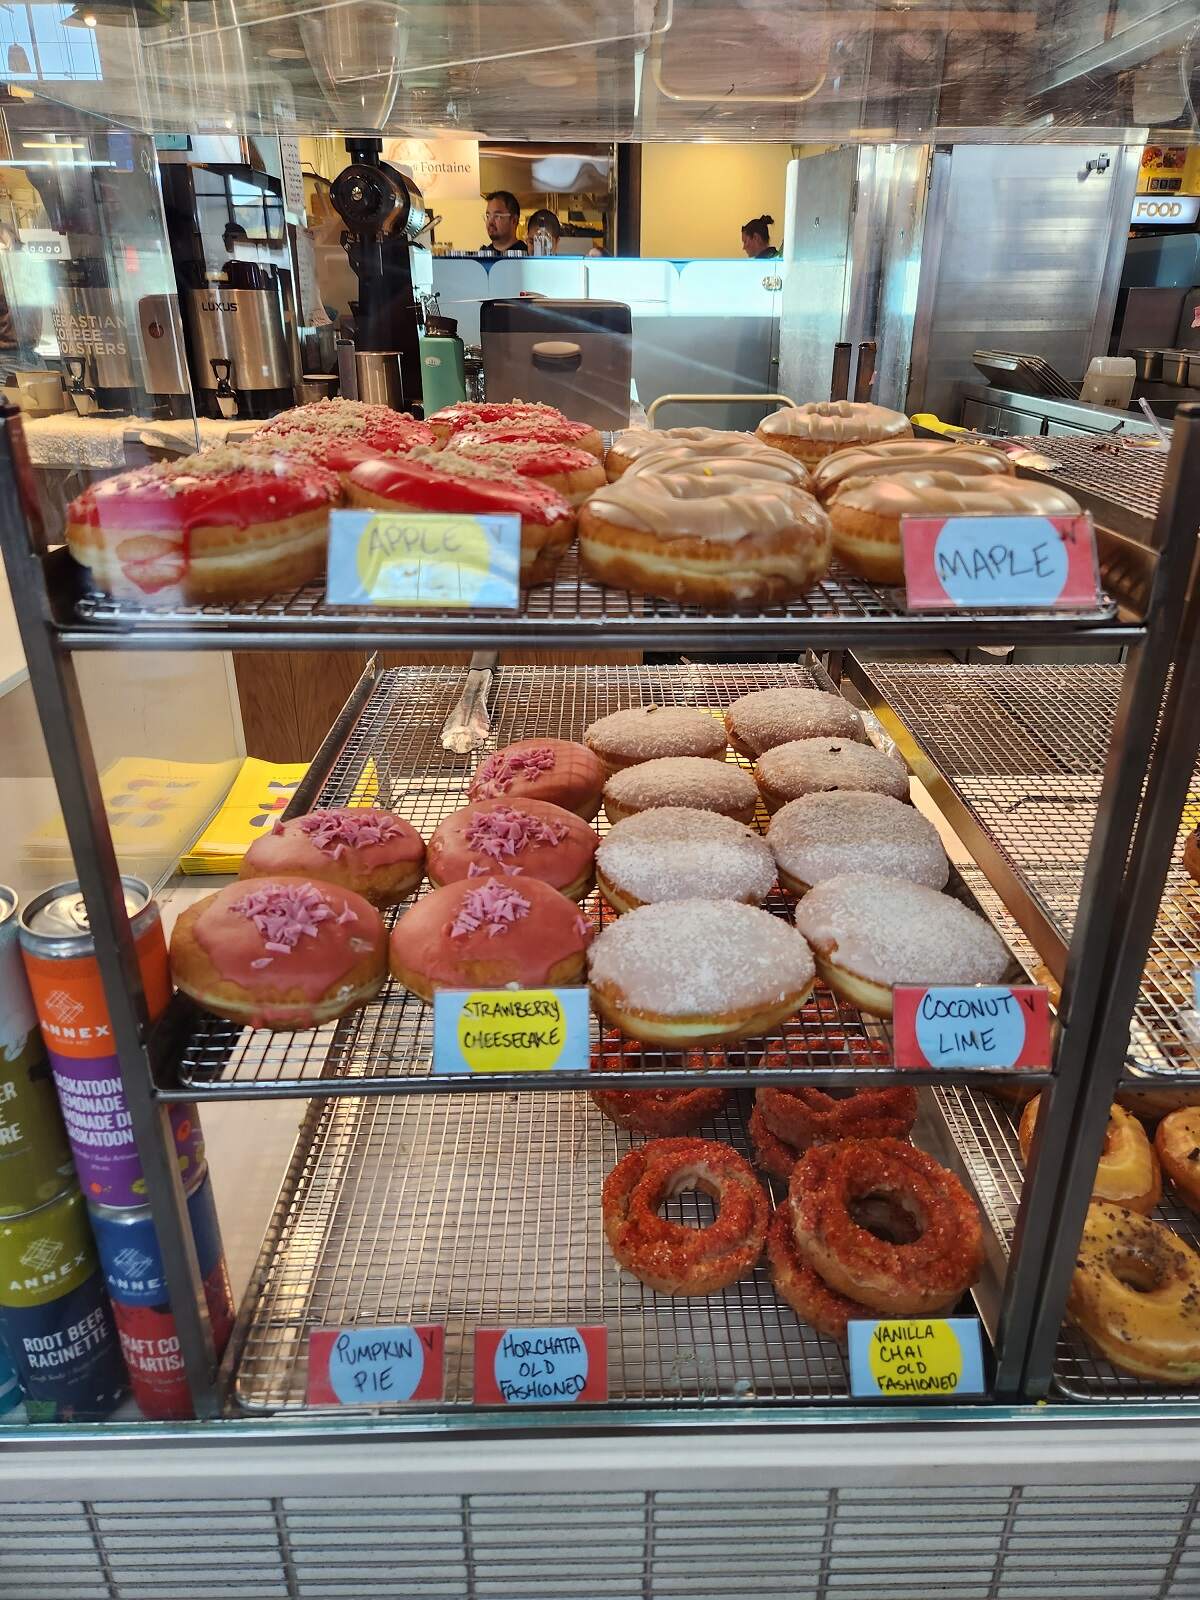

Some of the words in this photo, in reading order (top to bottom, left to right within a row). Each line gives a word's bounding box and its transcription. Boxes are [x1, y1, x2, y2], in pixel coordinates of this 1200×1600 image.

[420, 161, 471, 173] Fontaine
[1136, 202, 1182, 217] FOOD
[202, 302, 238, 312] LUXUS
[367, 525, 463, 558] APPLE
[937, 542, 1055, 582] MAPLE
[463, 1000, 561, 1022] STRAWBERRY
[922, 994, 1013, 1020] COCONUT
[41, 1019, 111, 1039] ANNEX
[463, 1027, 561, 1049] CHEESECAKE
[939, 1028, 997, 1053] LIME
[9, 1251, 87, 1292] ANNEX
[108, 1274, 168, 1291] ANNE
[23, 1331, 63, 1353] ROOT
[67, 1306, 105, 1342] BEER
[873, 1325, 935, 1343] VANILLA
[27, 1321, 109, 1369] RACINETTE
[336, 1334, 413, 1365] PUMPKIN
[503, 1333, 581, 1358] HORCHATA
[880, 1345, 923, 1362] CHAI
[519, 1359, 555, 1378] OLD
[896, 1361, 927, 1375] OLD
[354, 1366, 394, 1393] PIE
[499, 1374, 587, 1400] FASHIONED
[877, 1372, 958, 1391] FASHIONED
